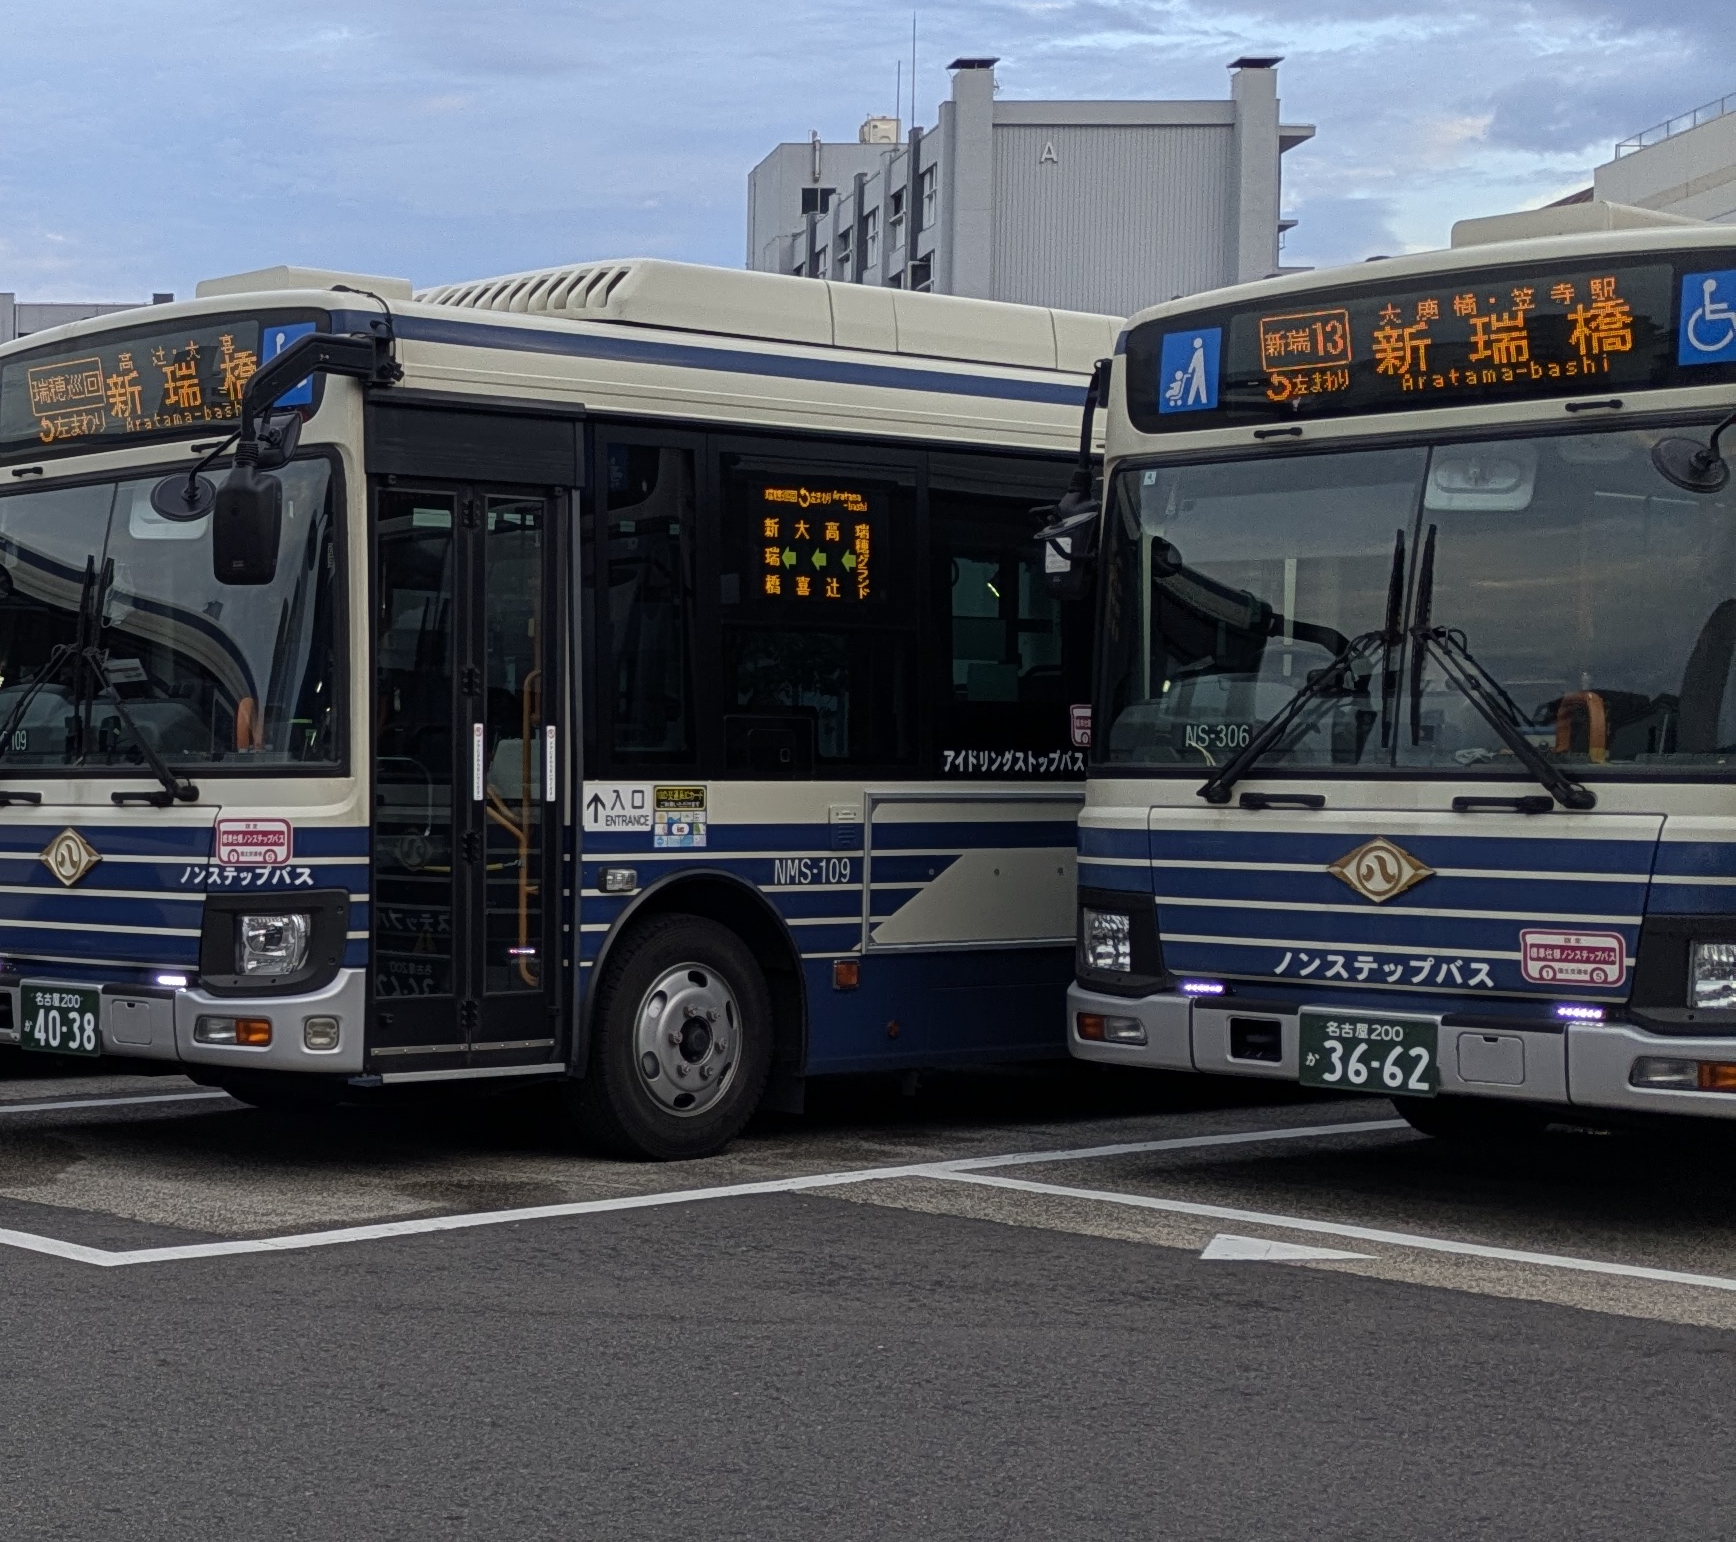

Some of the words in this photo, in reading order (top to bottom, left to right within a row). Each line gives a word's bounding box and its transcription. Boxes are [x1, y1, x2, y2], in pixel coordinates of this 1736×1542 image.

[1040, 142, 1058, 163] A
[1372, 297, 1634, 375] 新瑞橋
[1293, 369, 1349, 395] 左まわり
[1402, 353, 1610, 392] Aratama-bashi
[54, 410, 106, 439] 左まわり
[126, 400, 242, 432] Aratama-bash
[1185, 724, 1250, 748] NS-306
[943, 749, 1085, 773] アイドリングストップバス
[610, 789, 645, 811] 入口
[605, 814, 650, 827] ENTRANCE
[180, 865, 314, 886] ノンステップバス
[774, 858, 851, 885] NMS-109
[1273, 951, 1494, 988] ノンステップバス
[34, 1008, 96, 1051] 40-38
[1306, 1052, 1320, 1066] か
[1323, 1039, 1430, 1090] 36-62
